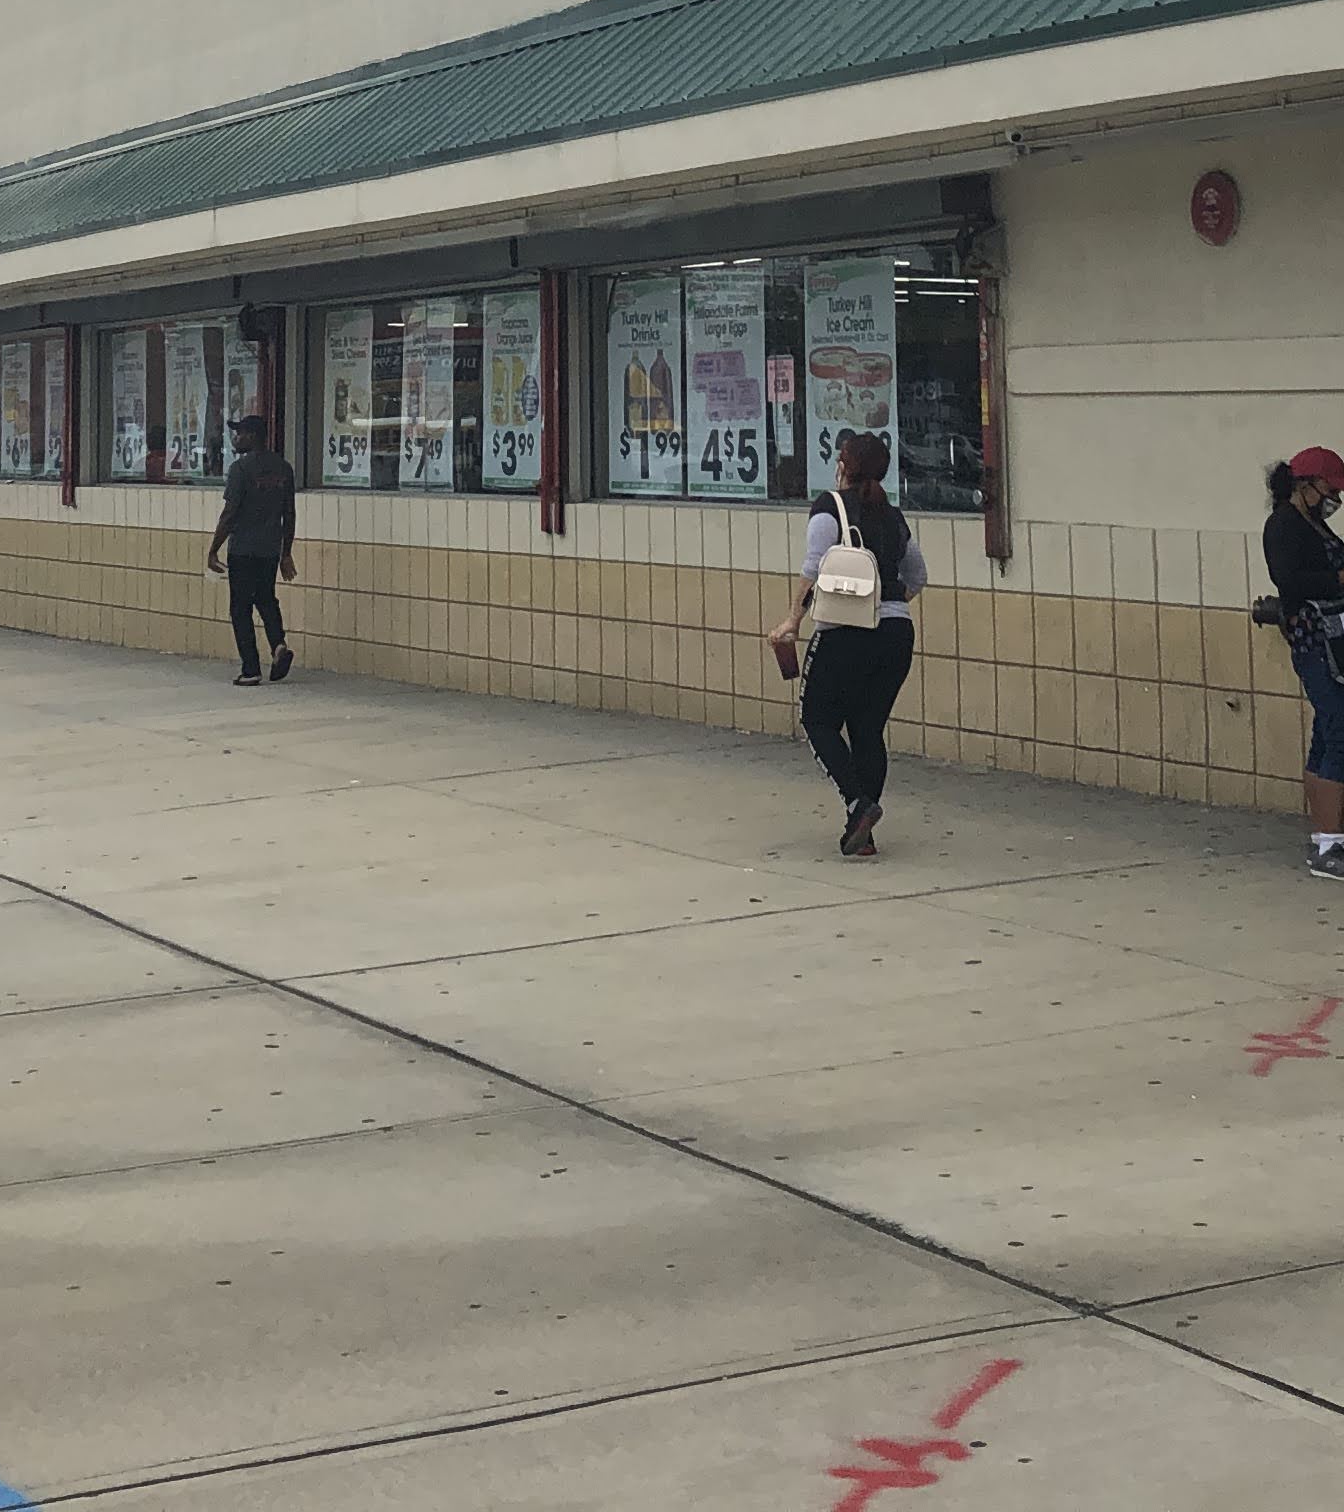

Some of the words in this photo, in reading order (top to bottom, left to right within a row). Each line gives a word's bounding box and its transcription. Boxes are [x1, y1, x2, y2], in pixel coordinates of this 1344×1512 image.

[735, 304, 759, 317] Farms
[827, 295, 856, 314] Turkey
[858, 294, 873, 311] Hill
[622, 311, 652, 326] Turkey
[654, 308, 669, 324] Hill
[826, 317, 841, 334] Ice
[843, 315, 875, 333] Cream
[631, 327, 661, 343] Drinks
[704, 321, 727, 337] Large
[729, 321, 748, 338] Eggs
